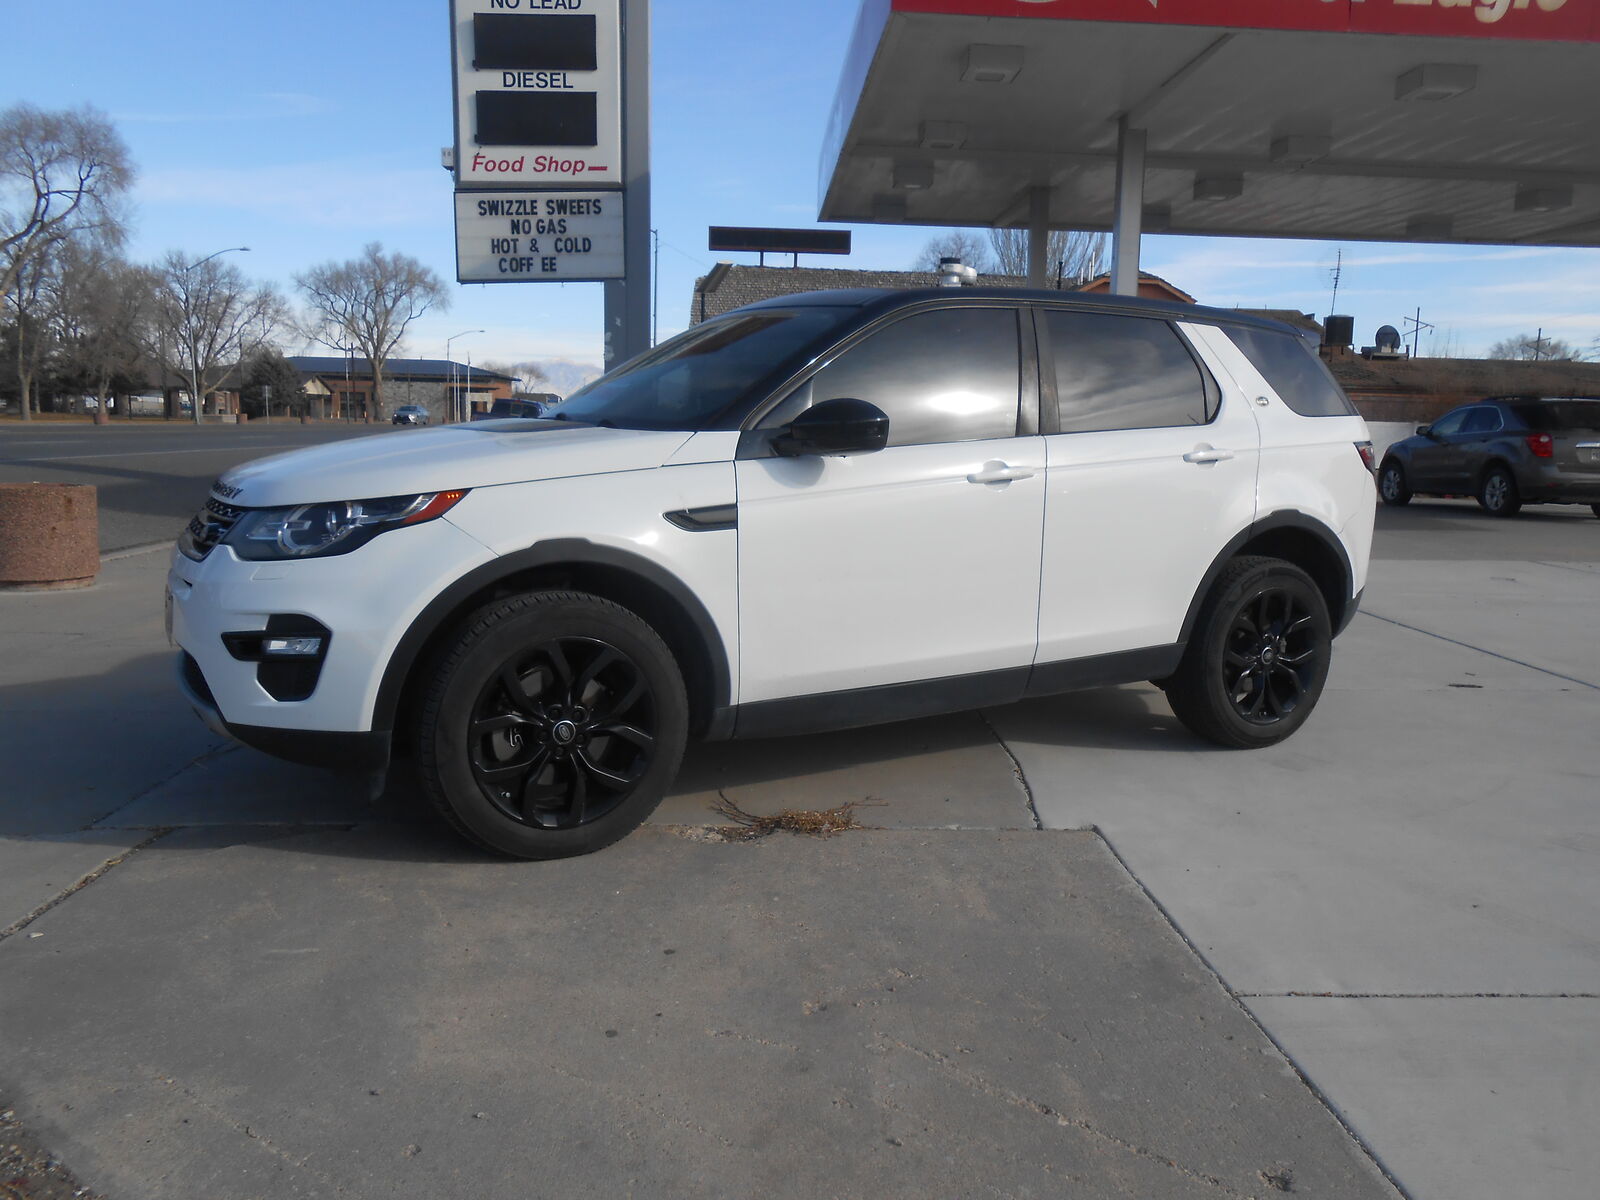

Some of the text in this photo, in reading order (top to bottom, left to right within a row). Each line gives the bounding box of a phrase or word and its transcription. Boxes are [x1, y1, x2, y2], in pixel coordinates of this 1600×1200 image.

[503, 72, 574, 88] DIESEL
[472, 155, 585, 175] Food Shop
[478, 199, 602, 216] SWIZZLE SWEETS
[511, 219, 567, 235] NO GAS
[491, 238, 592, 254] HOT & COLD
